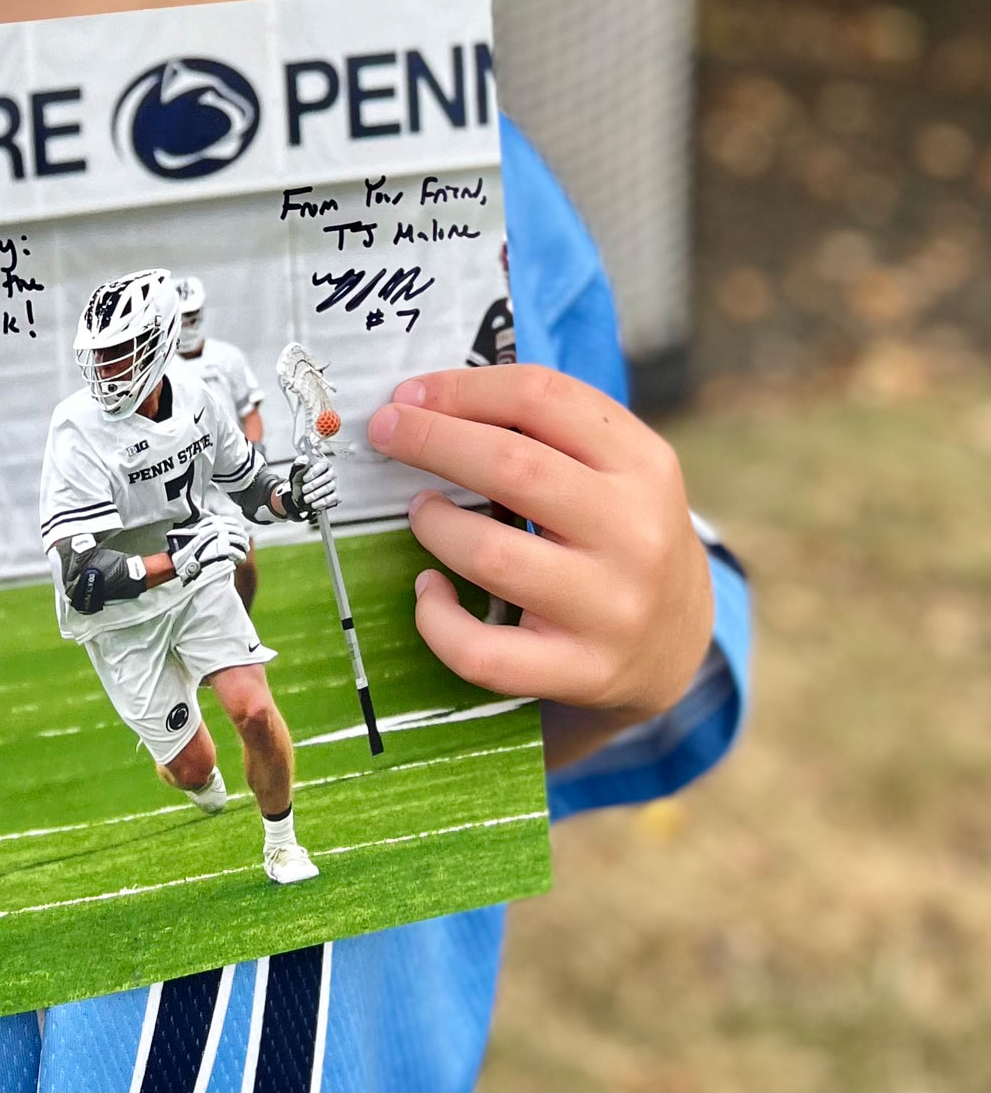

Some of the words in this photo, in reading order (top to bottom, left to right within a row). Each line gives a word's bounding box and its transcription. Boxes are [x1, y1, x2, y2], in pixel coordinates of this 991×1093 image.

[280, 186, 338, 220] From
[323, 221, 378, 251] TJ
[1, 269, 44, 298] the
[127, 456, 175, 484] PENN
[164, 459, 201, 529] 7
